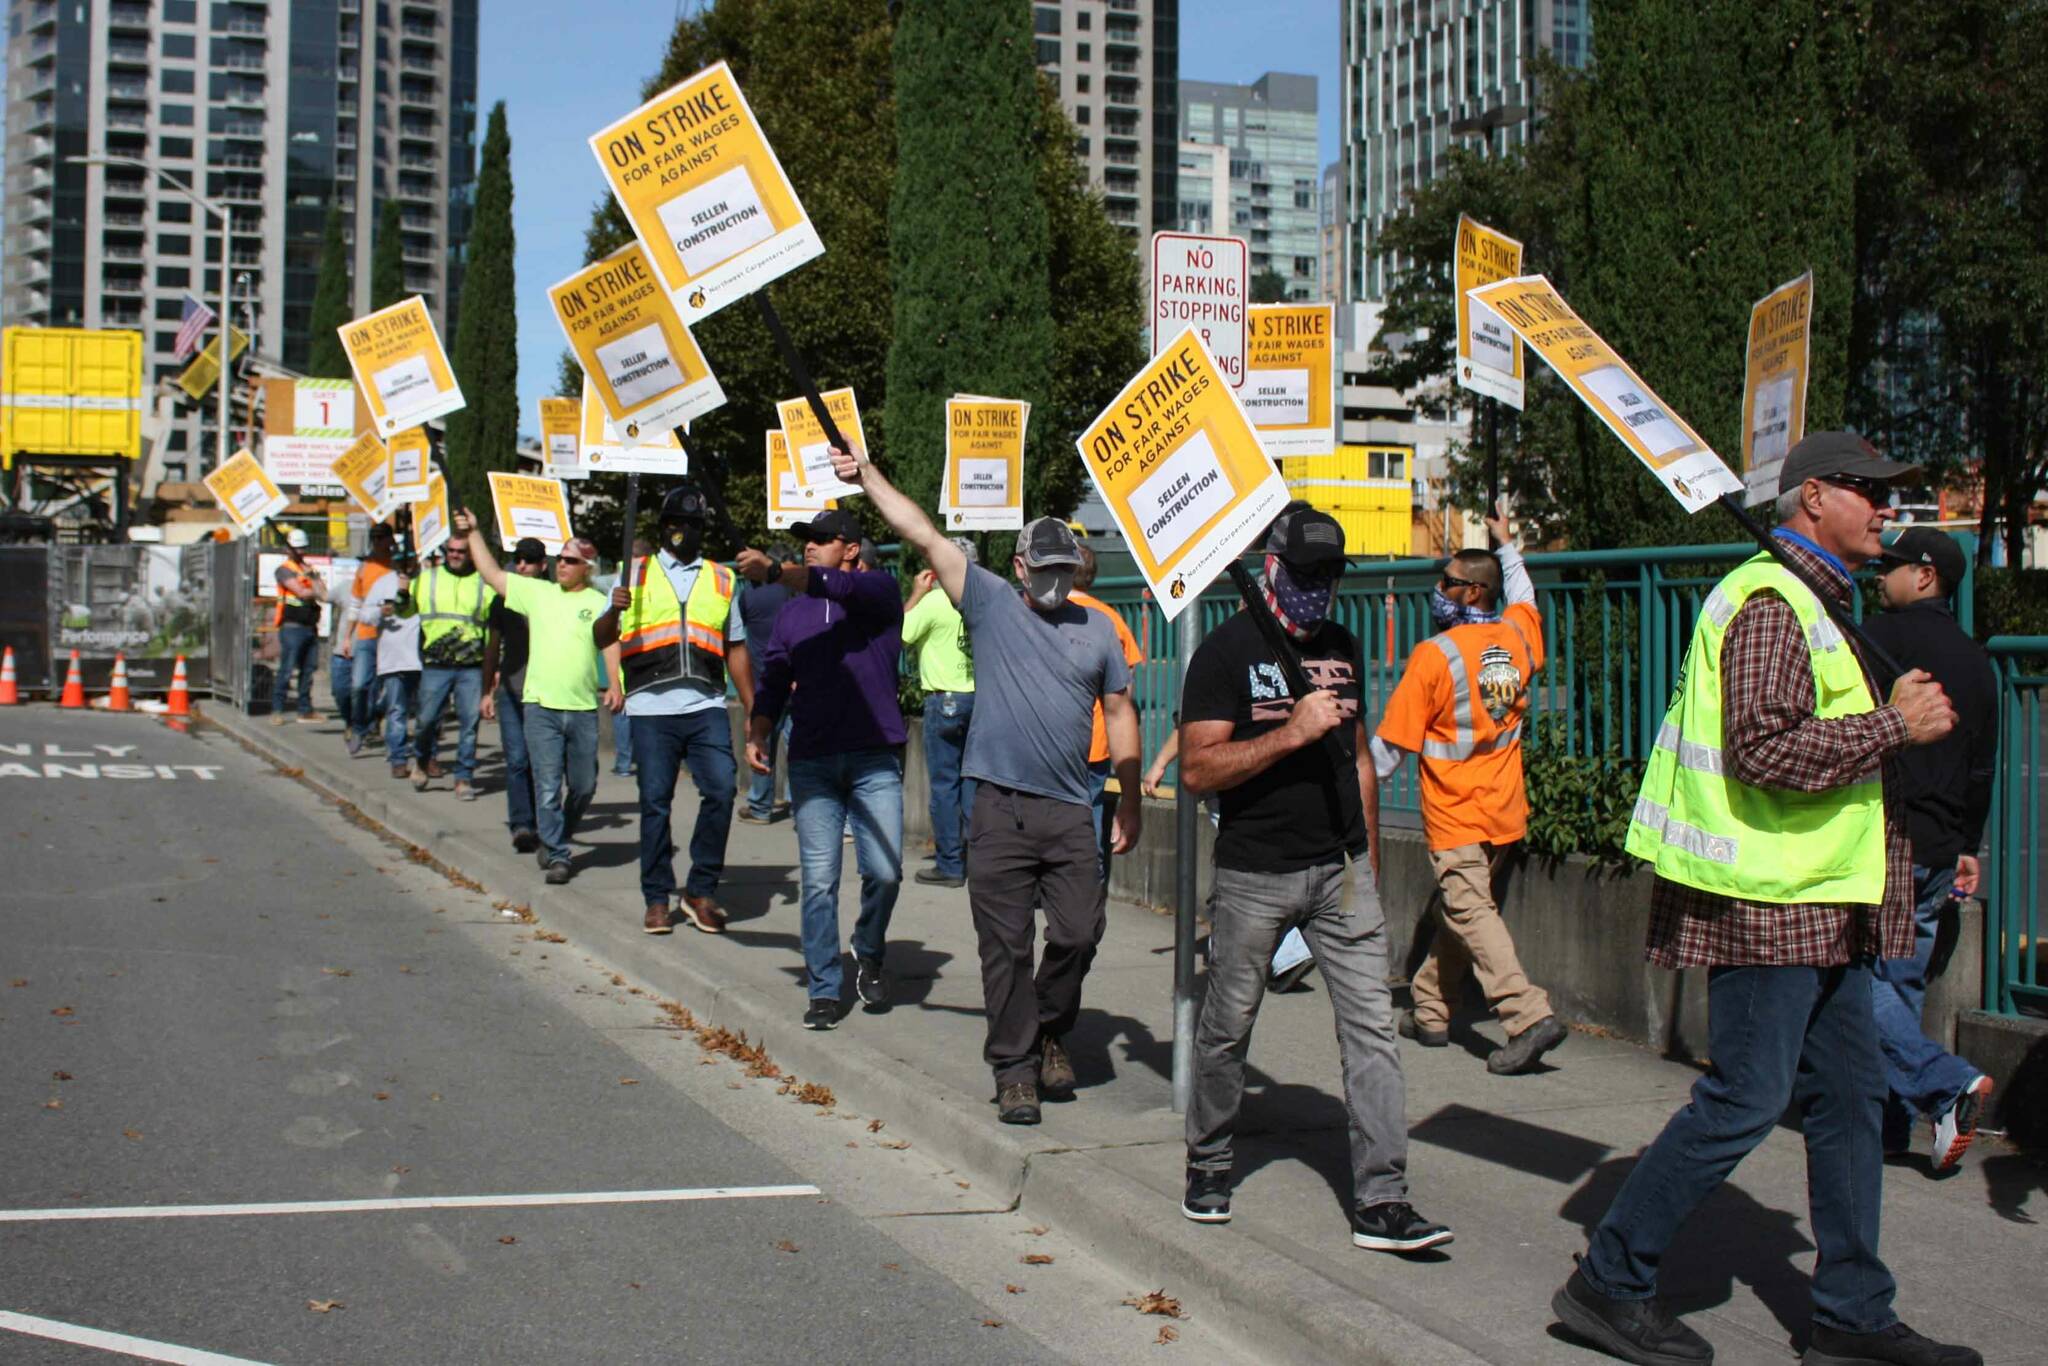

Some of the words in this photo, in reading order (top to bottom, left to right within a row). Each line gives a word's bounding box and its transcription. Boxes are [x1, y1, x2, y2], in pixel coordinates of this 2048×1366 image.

[609, 131, 646, 168] ON
[647, 83, 731, 146] STRIKE
[623, 162, 652, 186] FOR
[654, 143, 687, 168] FAIR
[689, 113, 740, 147] WAGES
[659, 144, 720, 186] AGAINST
[676, 204, 758, 252] CONSTRUCTION
[691, 201, 729, 227] SELLEN
[1187, 249, 1213, 269] NO
[1461, 229, 1477, 256] ON
[1481, 238, 1516, 275] STRIKE
[561, 290, 587, 318] ON
[585, 256, 647, 304] STRIKE
[571, 315, 592, 334] FOR
[593, 304, 616, 324] FAIR
[618, 283, 656, 308] WAGES
[598, 307, 642, 336] AGAINST
[1159, 300, 1241, 323] STOPPING
[1769, 290, 1808, 334] STRIKE
[350, 329, 371, 347] ON
[373, 308, 421, 338] STRIKE
[1248, 318, 1255, 336] N
[1264, 315, 1325, 336] STRIKE
[621, 351, 648, 369] SELLEN
[1254, 353, 1303, 363] AGAINST
[1257, 341, 1282, 350] FAIR
[1287, 340, 1325, 349] WAGES
[612, 358, 670, 388] CONSTRUCTION
[1093, 420, 1126, 464] ON
[1125, 348, 1201, 430] STRIKE
[1258, 387, 1287, 395] SELLEN
[320, 402, 328, 426] 1
[787, 408, 804, 422] ON
[954, 409, 972, 427] ON
[977, 409, 1018, 427] STRIKE
[1106, 451, 1132, 481] FOR
[1133, 423, 1162, 454] FAIR
[1162, 375, 1210, 421] WAGES
[1139, 413, 1193, 473] AGAINST
[301, 484, 345, 496] Sellen
[1146, 469, 1219, 540] CONSTRUCTION
[1157, 472, 1191, 508] SELLEN
[1187, 545, 1219, 577] Northwest
[1219, 512, 1256, 546] Carpenters
[1256, 493, 1275, 512] Union
[62, 628, 149, 644] Performance
